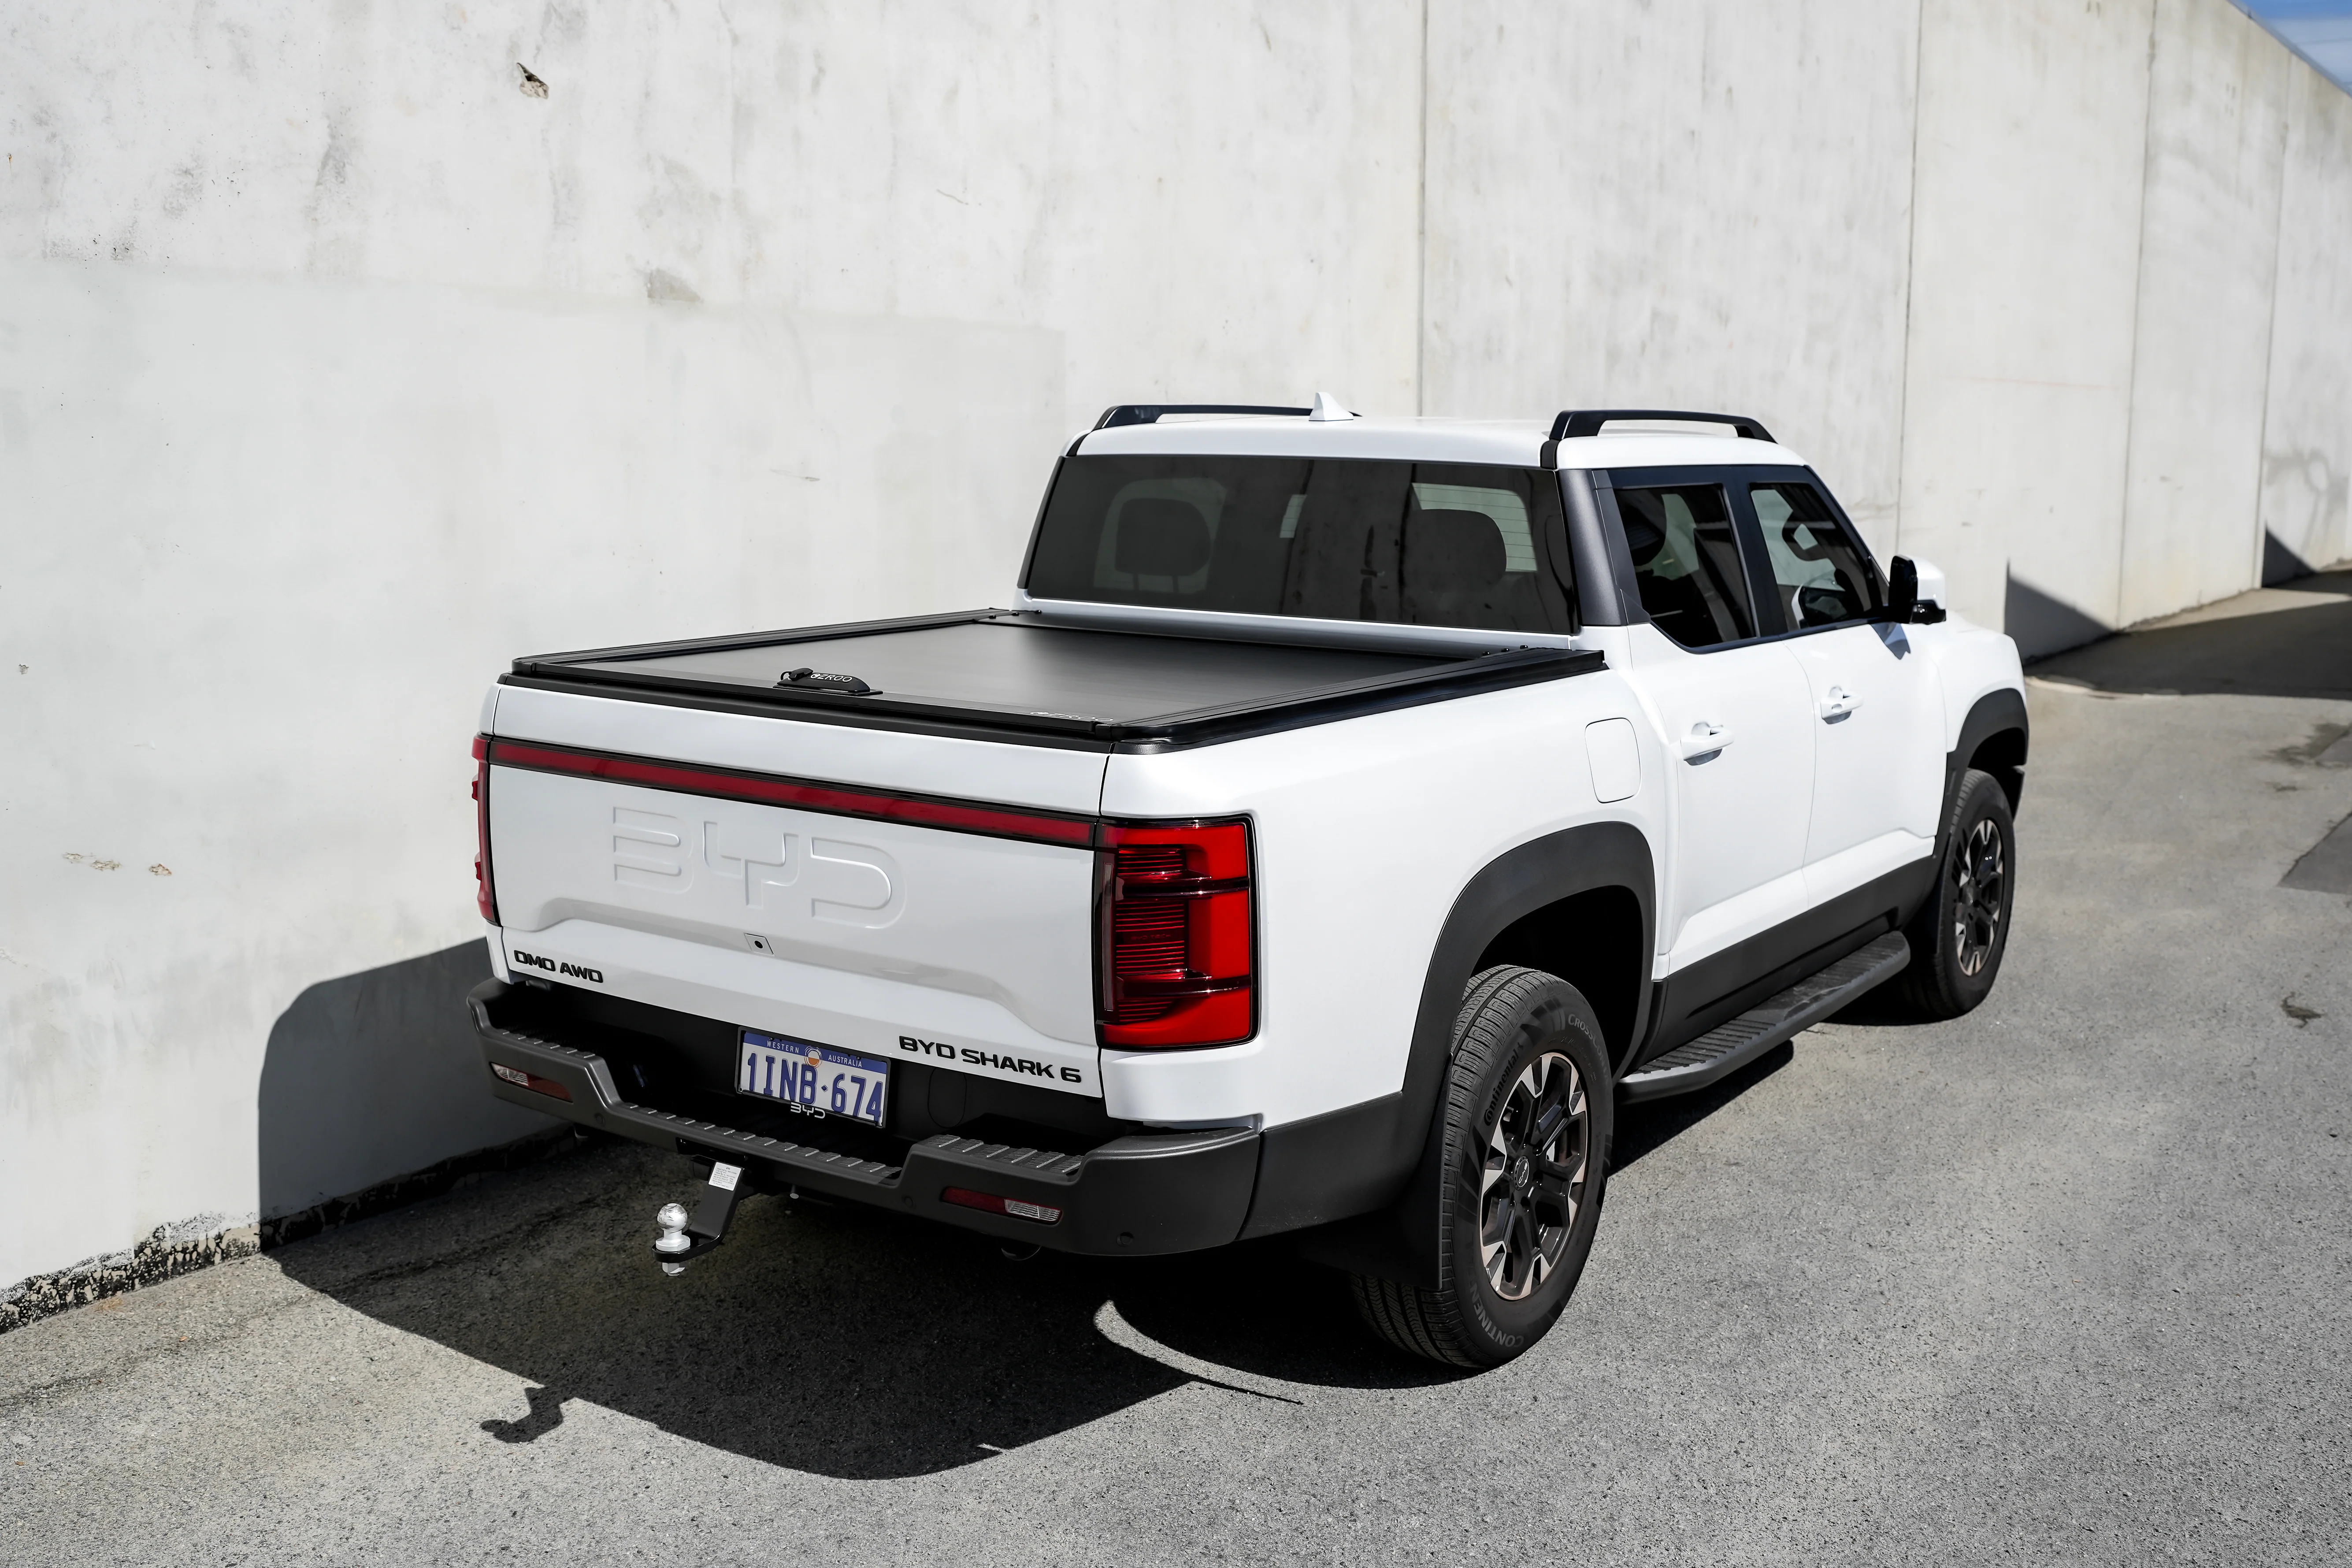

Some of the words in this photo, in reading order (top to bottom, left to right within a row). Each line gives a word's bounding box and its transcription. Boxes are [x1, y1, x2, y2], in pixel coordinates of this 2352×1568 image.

[613, 806, 907, 928] BYD
[514, 950, 556, 971] DMO
[560, 962, 603, 983] AWD
[767, 1041, 799, 1054] WESTERN
[828, 1055, 862, 1068] AUSTRALIA
[899, 1035, 955, 1059] BYD
[961, 1048, 1055, 1079] SHARK
[1060, 1066, 1082, 1083] 6
[1484, 1048, 1519, 1126] Continental
[790, 1102, 825, 1119] BYD
